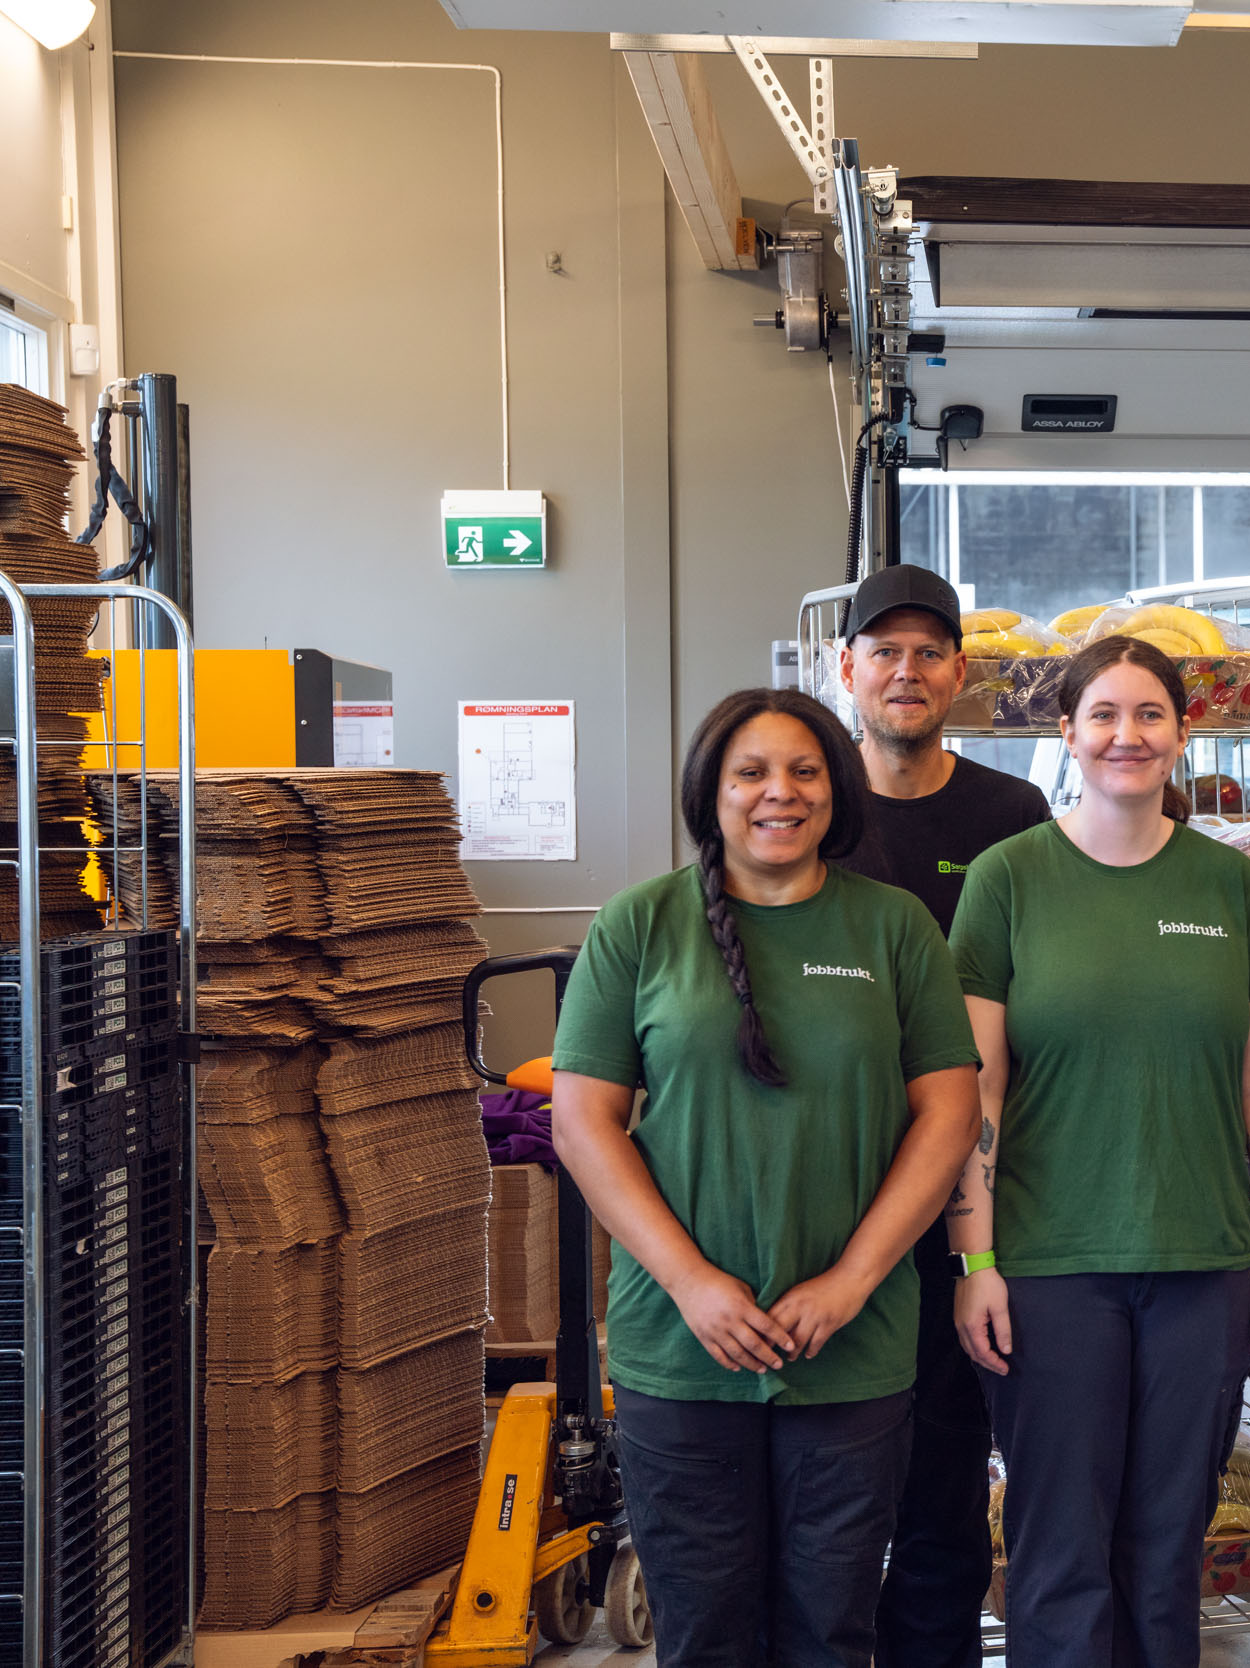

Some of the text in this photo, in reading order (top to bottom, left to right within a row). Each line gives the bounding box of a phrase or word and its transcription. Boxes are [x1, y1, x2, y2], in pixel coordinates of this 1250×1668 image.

[1032, 420, 1104, 428] ASSA ABLOY
[1157, 919, 1228, 938] jobbfrukt.
[802, 962, 875, 982] jobbfrukt.
